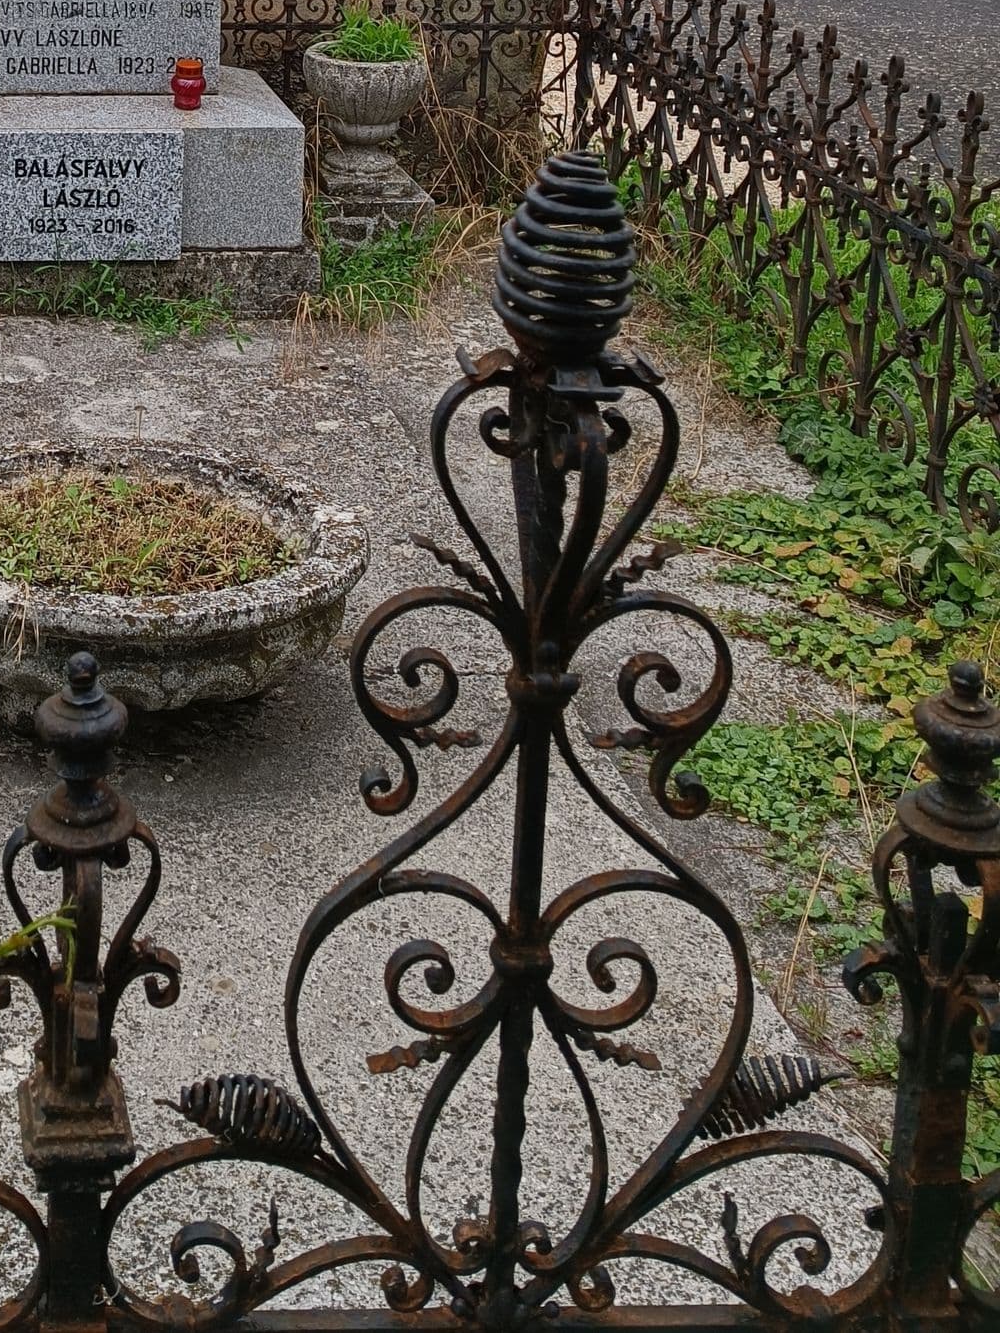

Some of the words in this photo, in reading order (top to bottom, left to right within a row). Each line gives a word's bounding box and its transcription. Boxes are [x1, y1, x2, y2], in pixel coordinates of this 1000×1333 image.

[36, 23, 123, 47] LÁSZLÓNÉ
[7, 56, 98, 74] GABRIELLA
[14, 154, 146, 179] BALÁSFALVY
[43, 183, 121, 208] LÁSZLÓ
[29, 219, 68, 234] 1923
[93, 218, 136, 234] 2016
